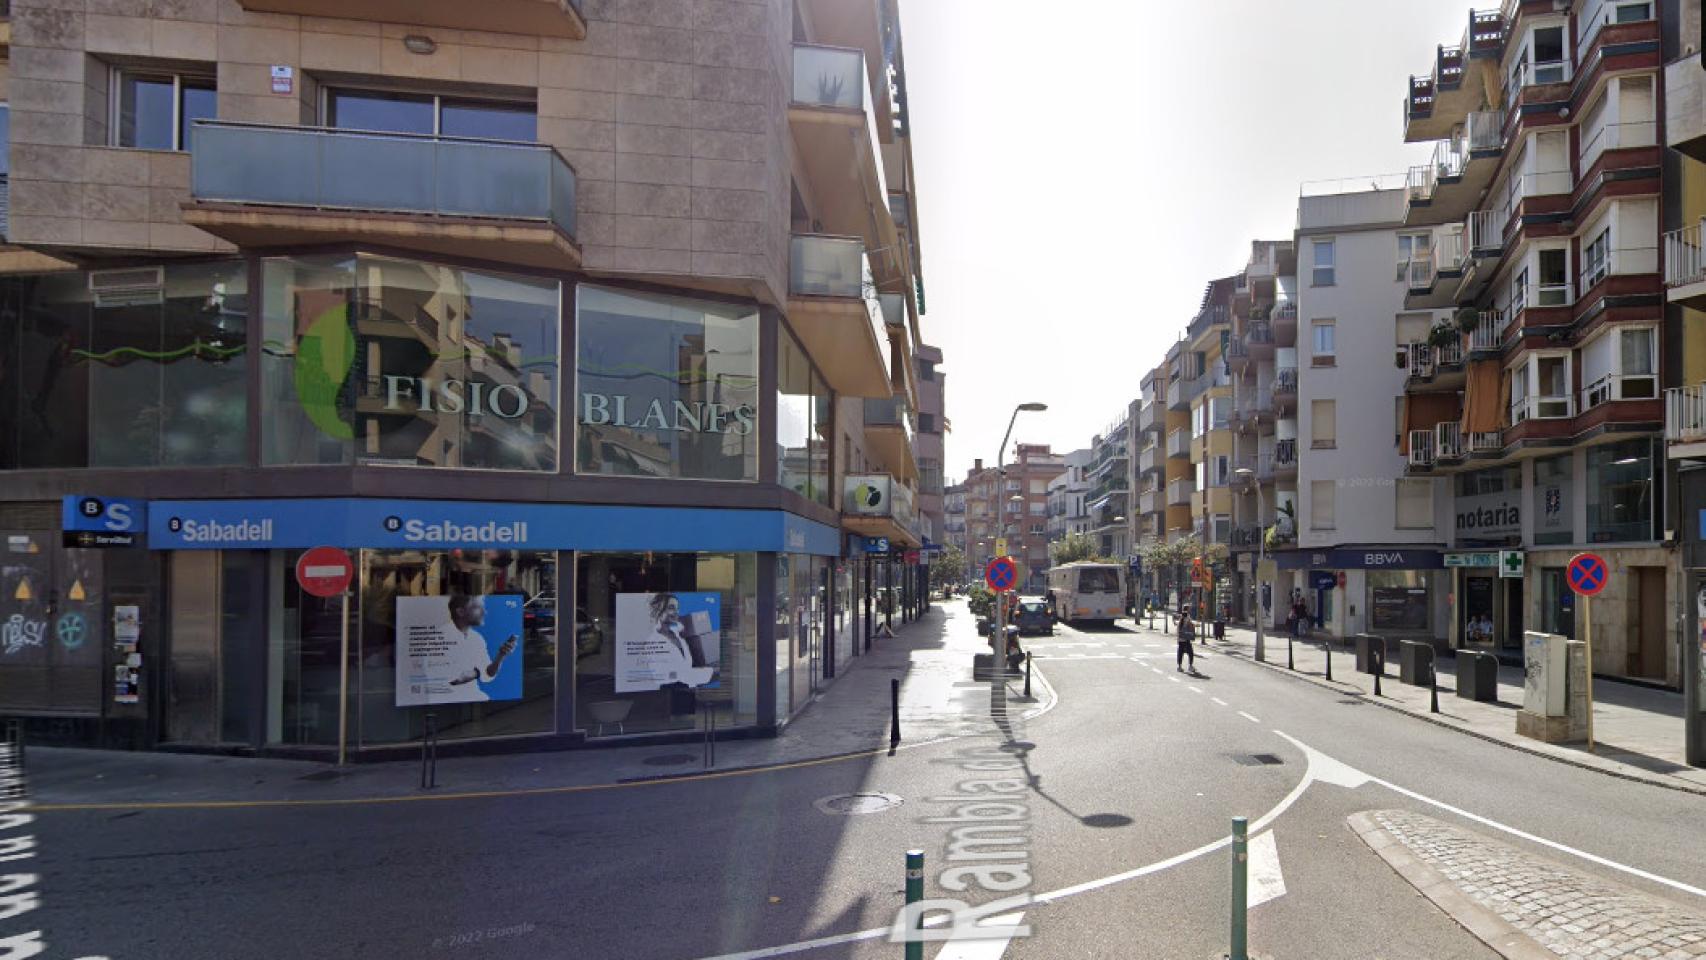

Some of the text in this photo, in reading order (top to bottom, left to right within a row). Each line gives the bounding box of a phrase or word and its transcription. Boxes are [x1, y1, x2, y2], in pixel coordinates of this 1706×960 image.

[383, 375, 755, 436] FISIO BLANES
[85, 502, 132, 531] B S
[1456, 501, 1519, 529] notaria
[182, 518, 273, 542] Sabadell
[404, 519, 528, 543] Sabadell
[1364, 552, 1404, 565] BBVA
